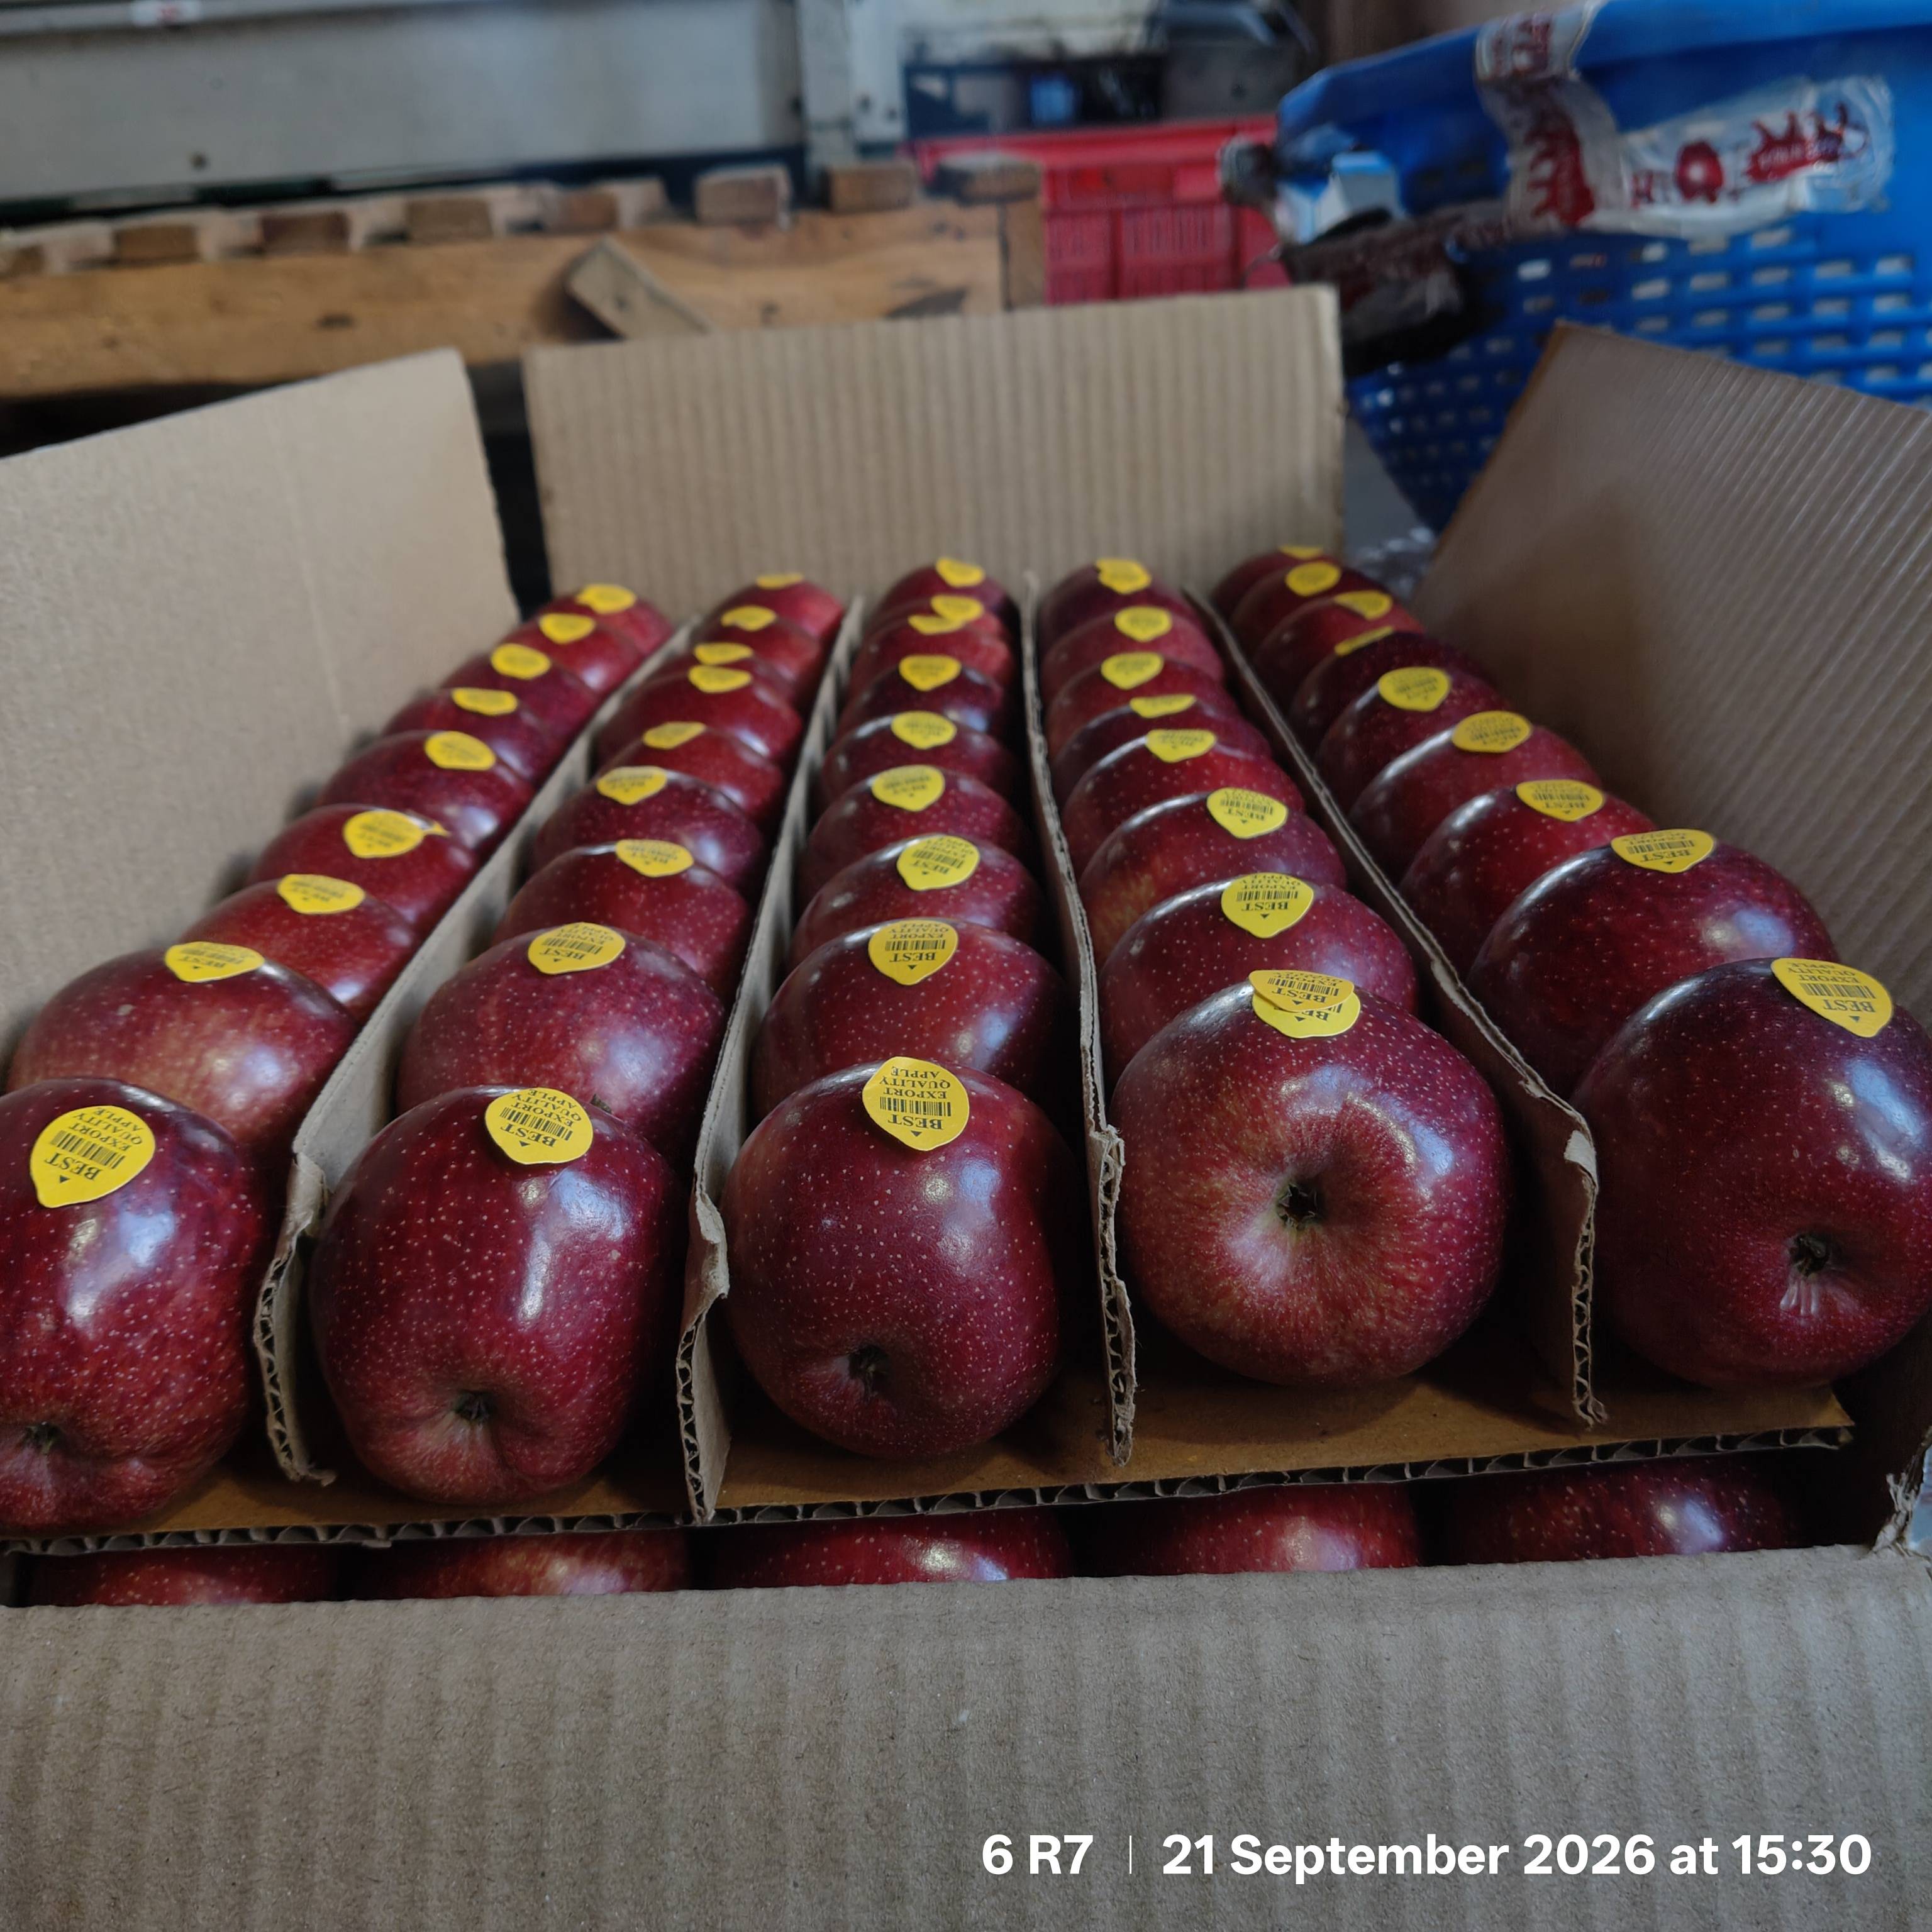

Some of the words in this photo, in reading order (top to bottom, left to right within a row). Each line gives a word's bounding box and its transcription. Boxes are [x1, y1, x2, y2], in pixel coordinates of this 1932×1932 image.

[1639, 849, 1692, 862] BEST
[1241, 902, 1289, 911] BEST
[539, 948, 586, 960] BEST
[889, 952, 936, 962] BEST
[1787, 966, 1855, 977] QUALITY
[1799, 974, 1859, 983] EXPORT
[1272, 987, 1326, 1003] BEST
[1823, 999, 1875, 1013] BEST
[891, 1067, 940, 1079] APPLE
[879, 1076, 951, 1090] QUALITY
[526, 1089, 577, 1108] APPLE
[883, 1087, 948, 1099] EXPORT
[510, 1101, 574, 1127] EXPORT
[511, 1094, 582, 1121] QUALITY
[94, 1108, 143, 1132] APPLE
[888, 1114, 943, 1130] BEST
[72, 1112, 143, 1145] QUALITY
[500, 1123, 557, 1148] BEST
[69, 1121, 132, 1152] EXPORT
[44, 1152, 103, 1182] BEST
